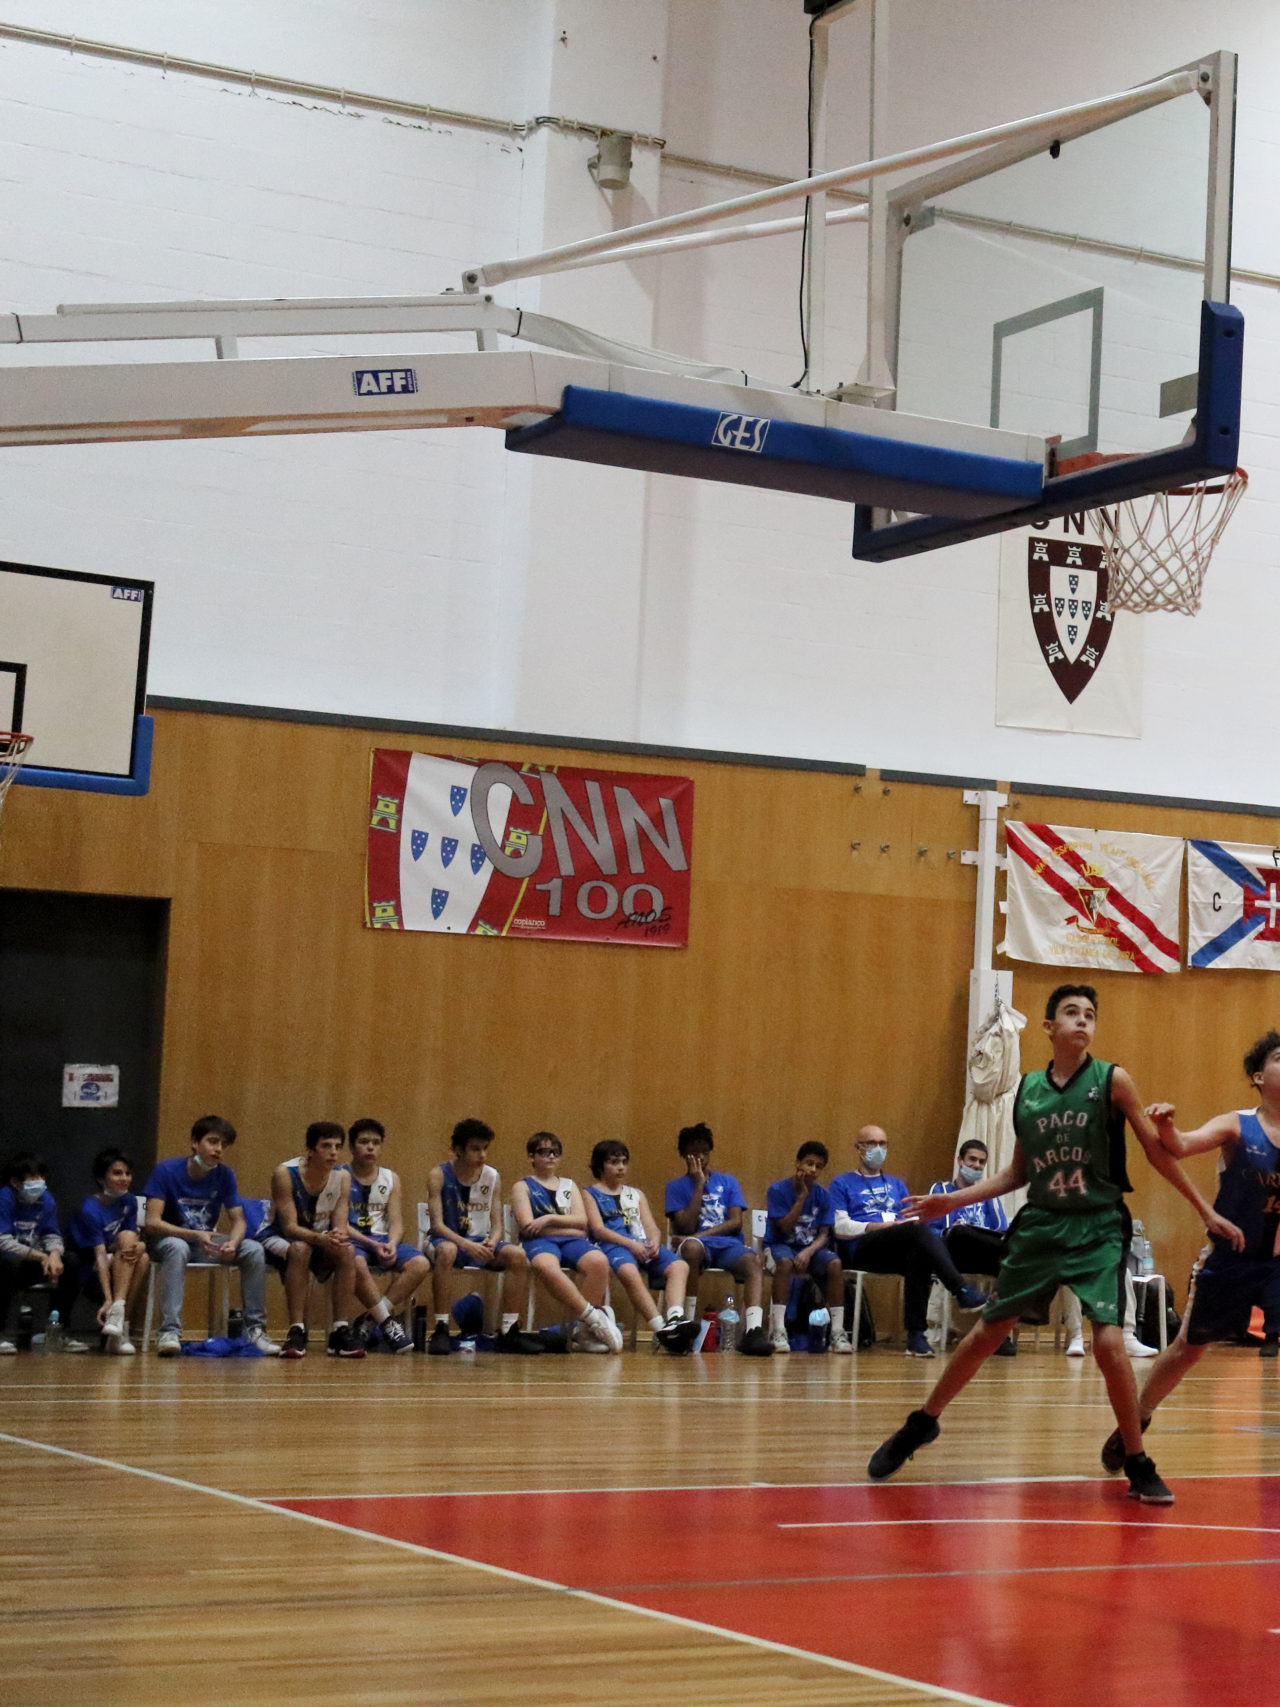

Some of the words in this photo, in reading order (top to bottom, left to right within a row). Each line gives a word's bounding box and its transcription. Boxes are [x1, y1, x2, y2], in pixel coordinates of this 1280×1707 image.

[360, 371, 407, 393] AFF
[718, 415, 769, 451] GES
[112, 588, 138, 600] AFF
[470, 761, 689, 878] CNN
[1272, 850, 1280, 867] F
[535, 877, 665, 923] 100
[1212, 891, 1222, 912] C
[1033, 1146, 1092, 1173] ARCOS
[1048, 1168, 1088, 1198] 44
